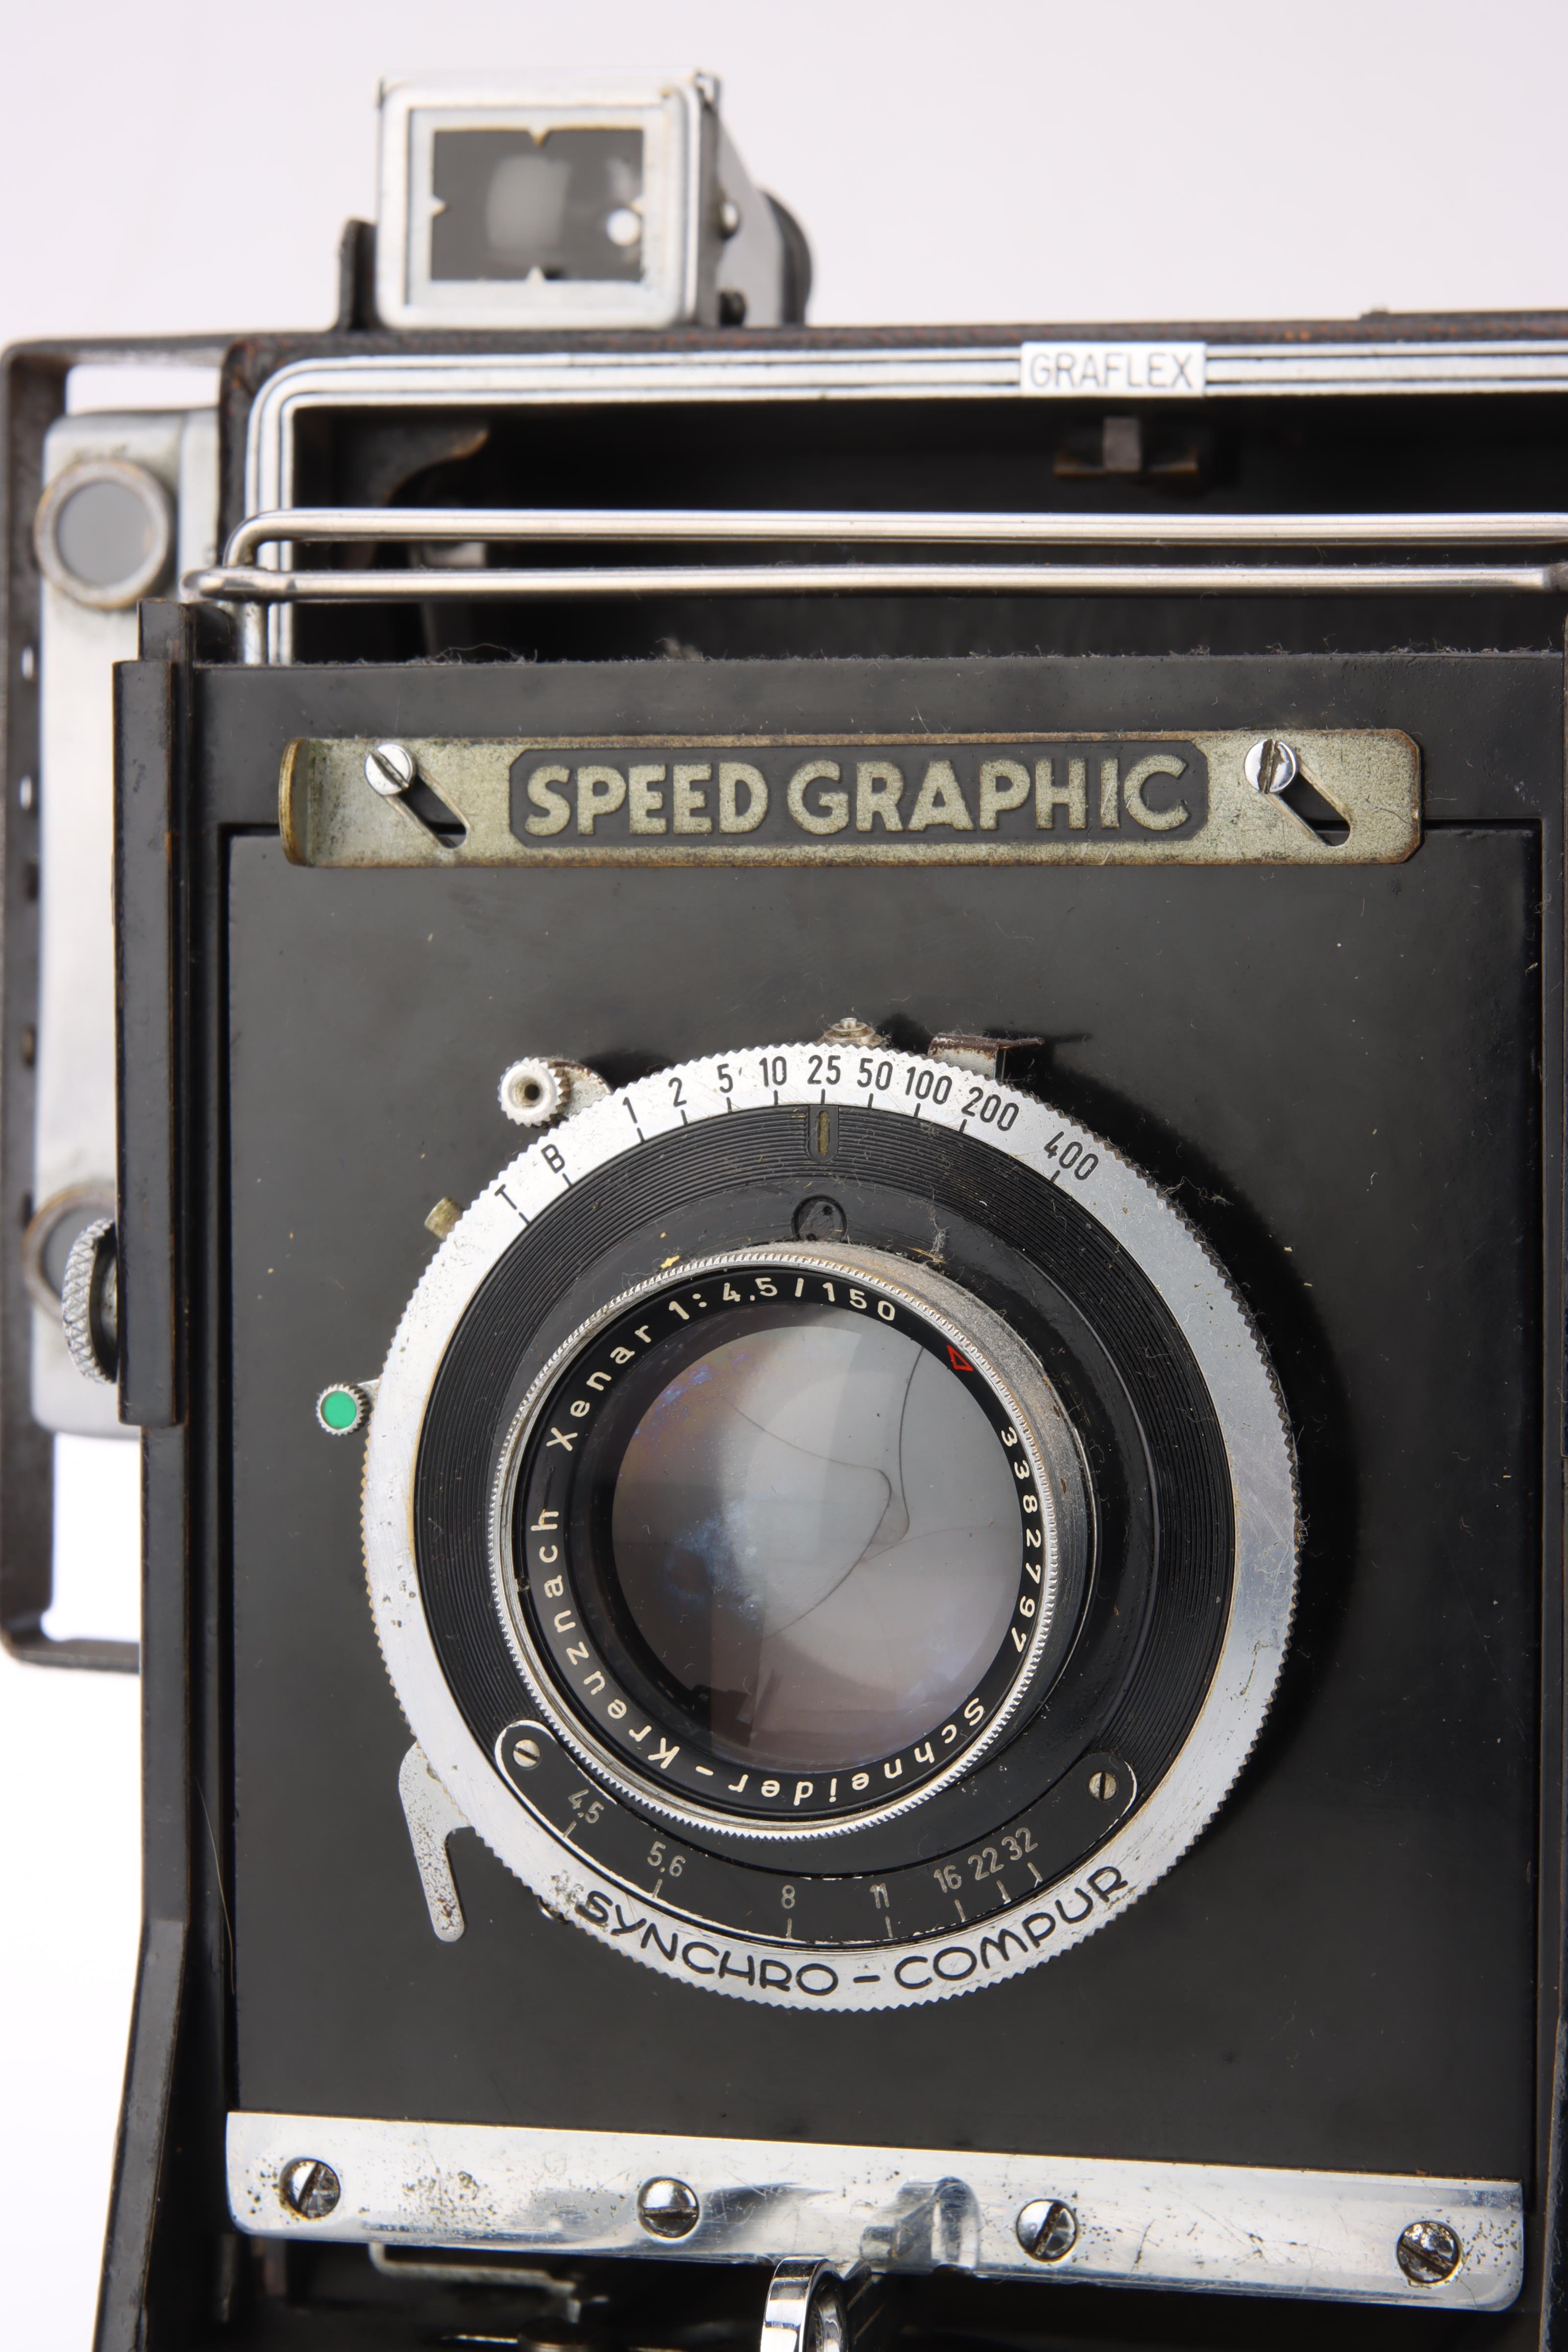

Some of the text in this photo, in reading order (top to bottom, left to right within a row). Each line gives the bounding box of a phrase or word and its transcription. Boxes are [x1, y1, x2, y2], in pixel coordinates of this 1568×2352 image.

[1028, 351, 1194, 387] GRAFLEX
[524, 754, 1190, 836] SPEED GRAPHIC
[494, 1054, 1100, 1209] T B 1 2 5 10 25 50 100 200 400
[546, 1323, 653, 1451] Xenar
[1001, 1426, 1042, 1652] 3382797
[647, 1841, 686, 1877] 5.6
[781, 1885, 795, 1909] 8
[869, 1884, 890, 1908] 11
[933, 1865, 962, 1892] 16
[967, 1846, 1004, 1881] 22
[1001, 1828, 1038, 1861] 32
